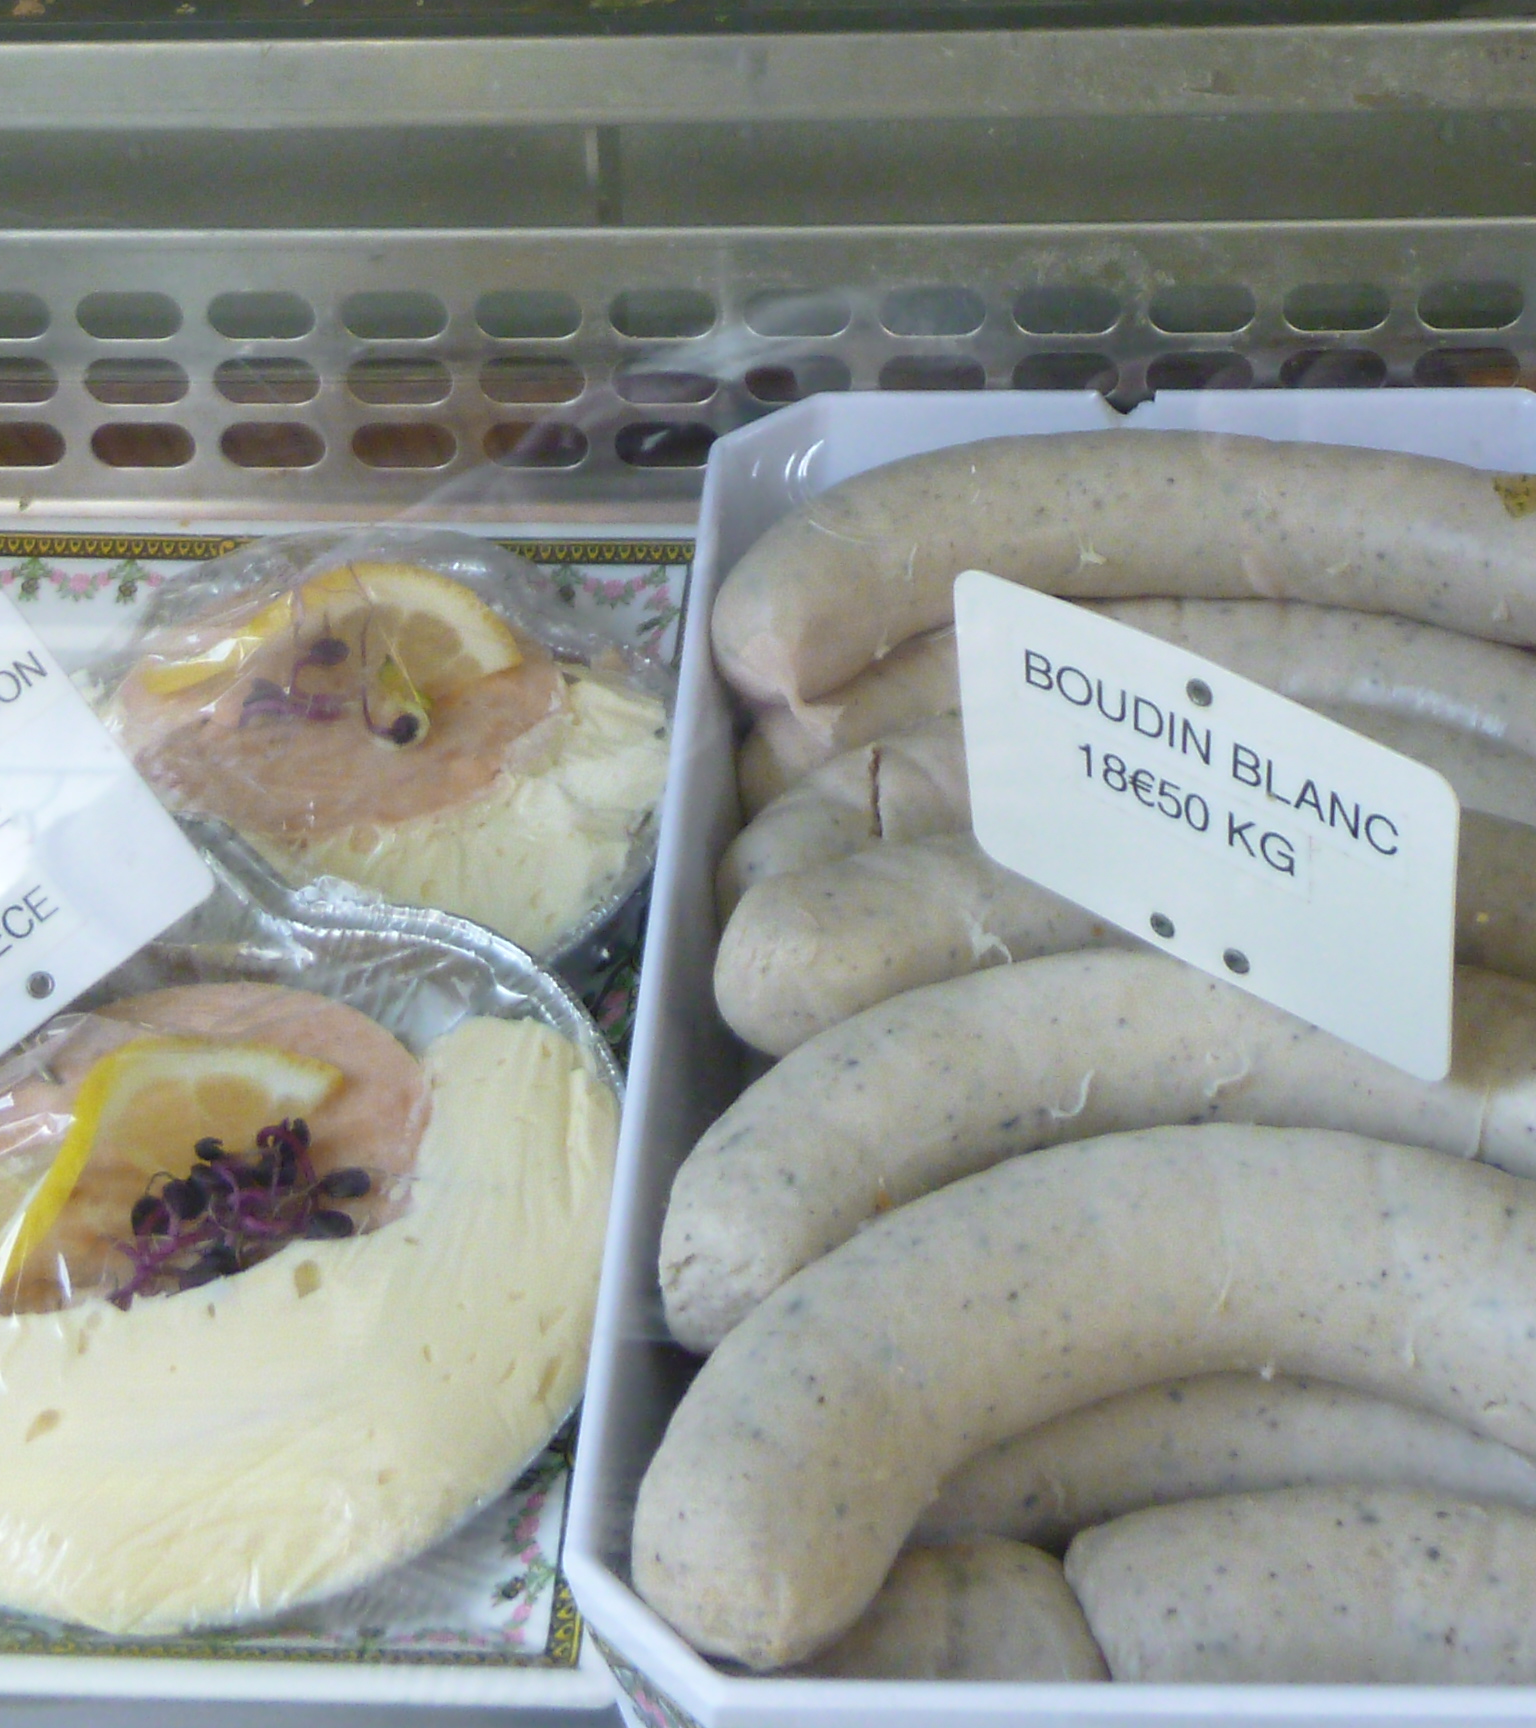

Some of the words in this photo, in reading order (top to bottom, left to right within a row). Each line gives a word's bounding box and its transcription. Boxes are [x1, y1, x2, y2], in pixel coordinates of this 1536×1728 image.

[1024, 648, 1212, 765] BOUDIN
[1232, 743, 1399, 856] BLANC
[1078, 743, 1209, 833] 18€50
[1228, 811, 1296, 876] KG
